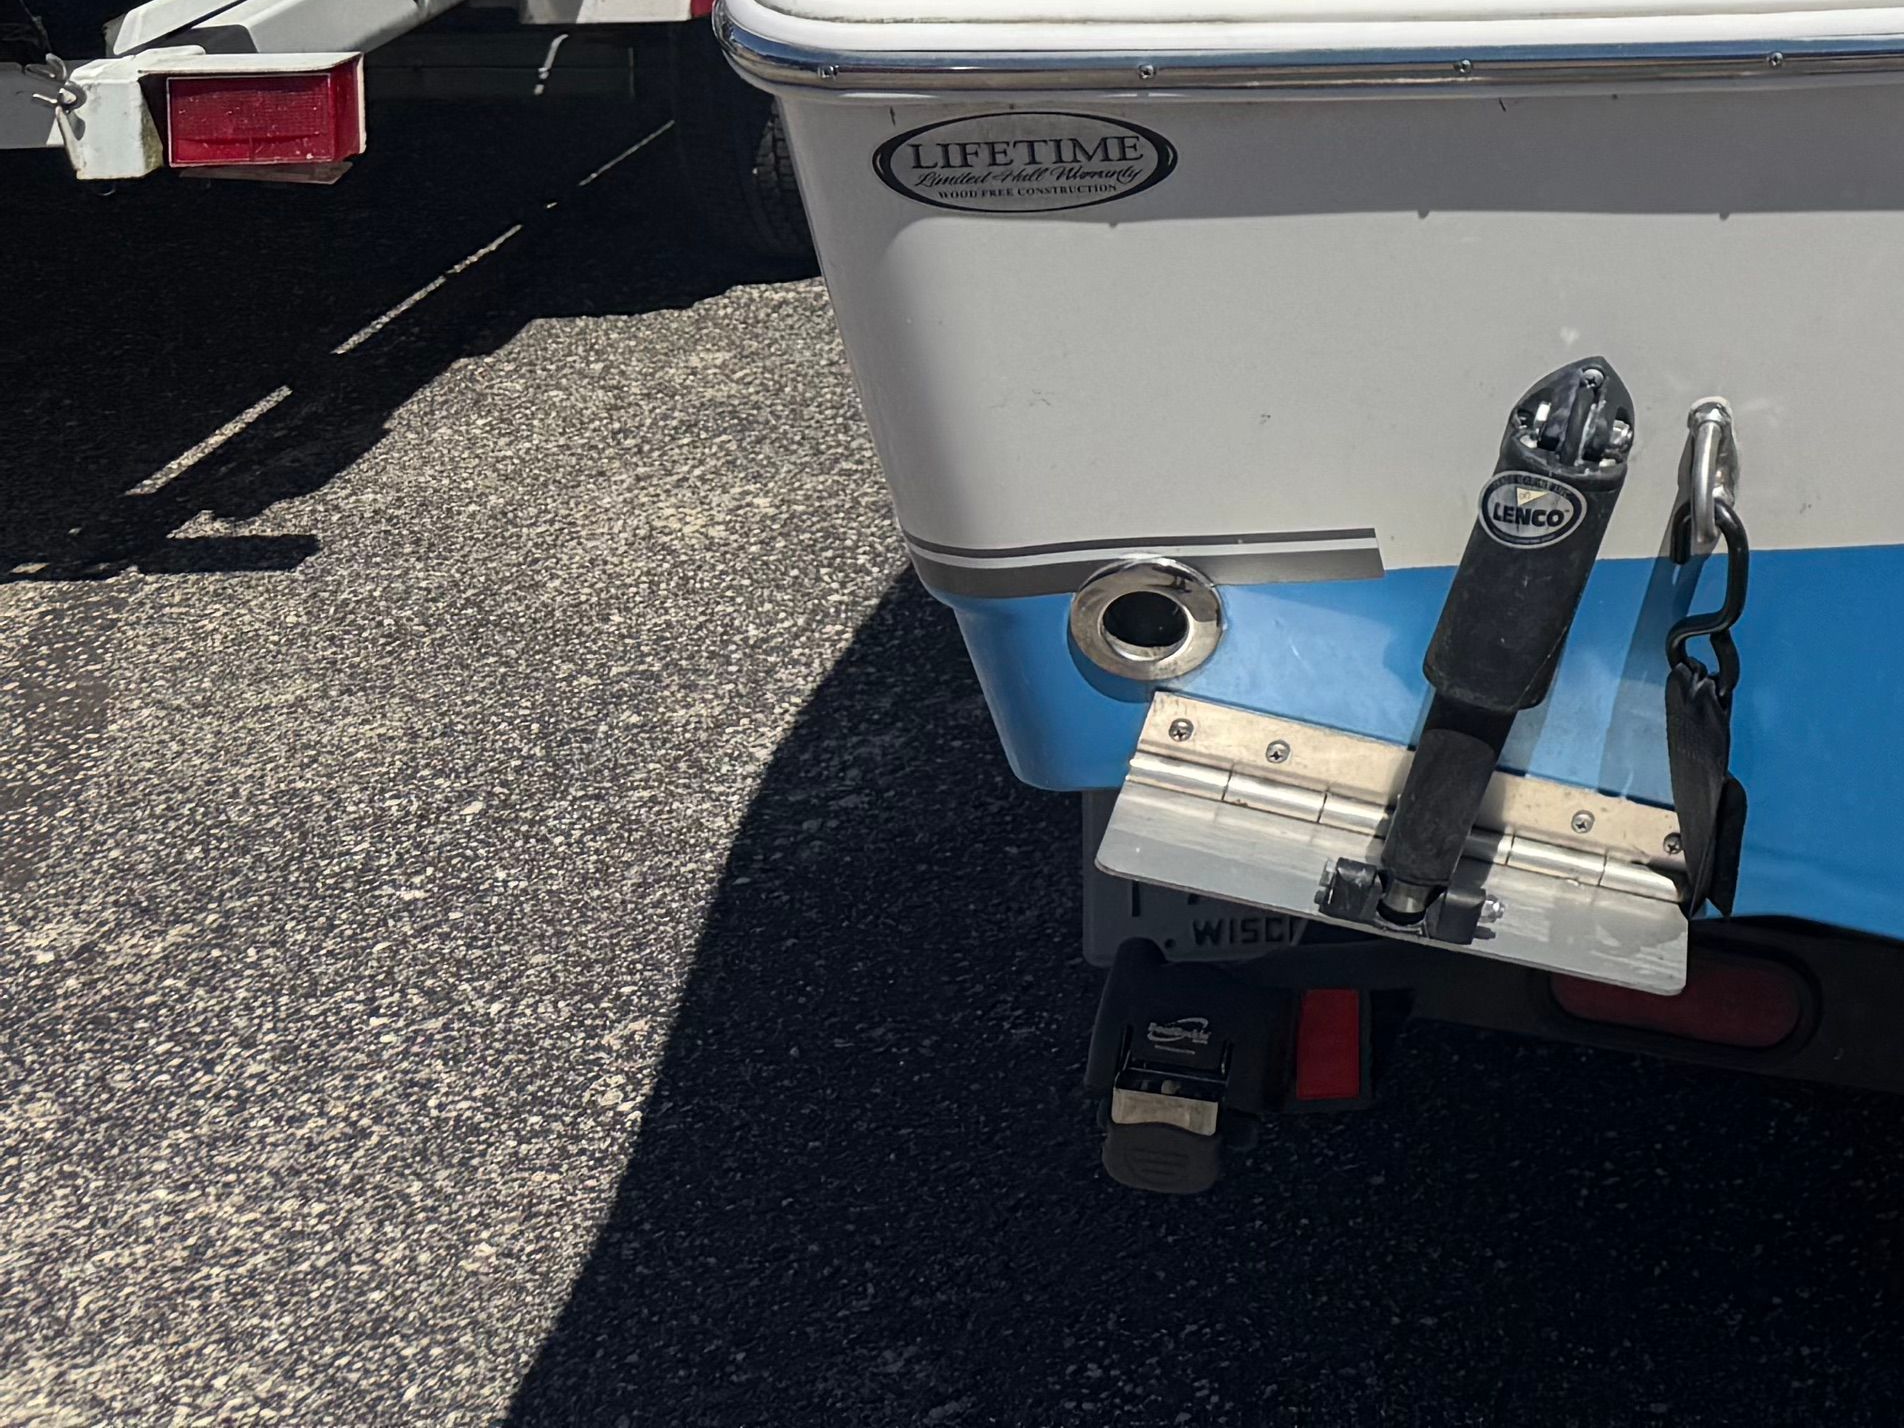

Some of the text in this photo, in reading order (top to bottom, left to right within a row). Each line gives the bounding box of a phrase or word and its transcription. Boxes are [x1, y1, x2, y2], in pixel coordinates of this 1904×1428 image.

[907, 135, 1144, 170] LIFETIME
[914, 164, 1143, 188] Limited Hull Warranty
[938, 184, 1117, 199] WOOD FREE CONSTRUCTION
[1493, 502, 1565, 527] LENCO
[1193, 917, 1304, 946] WISC
